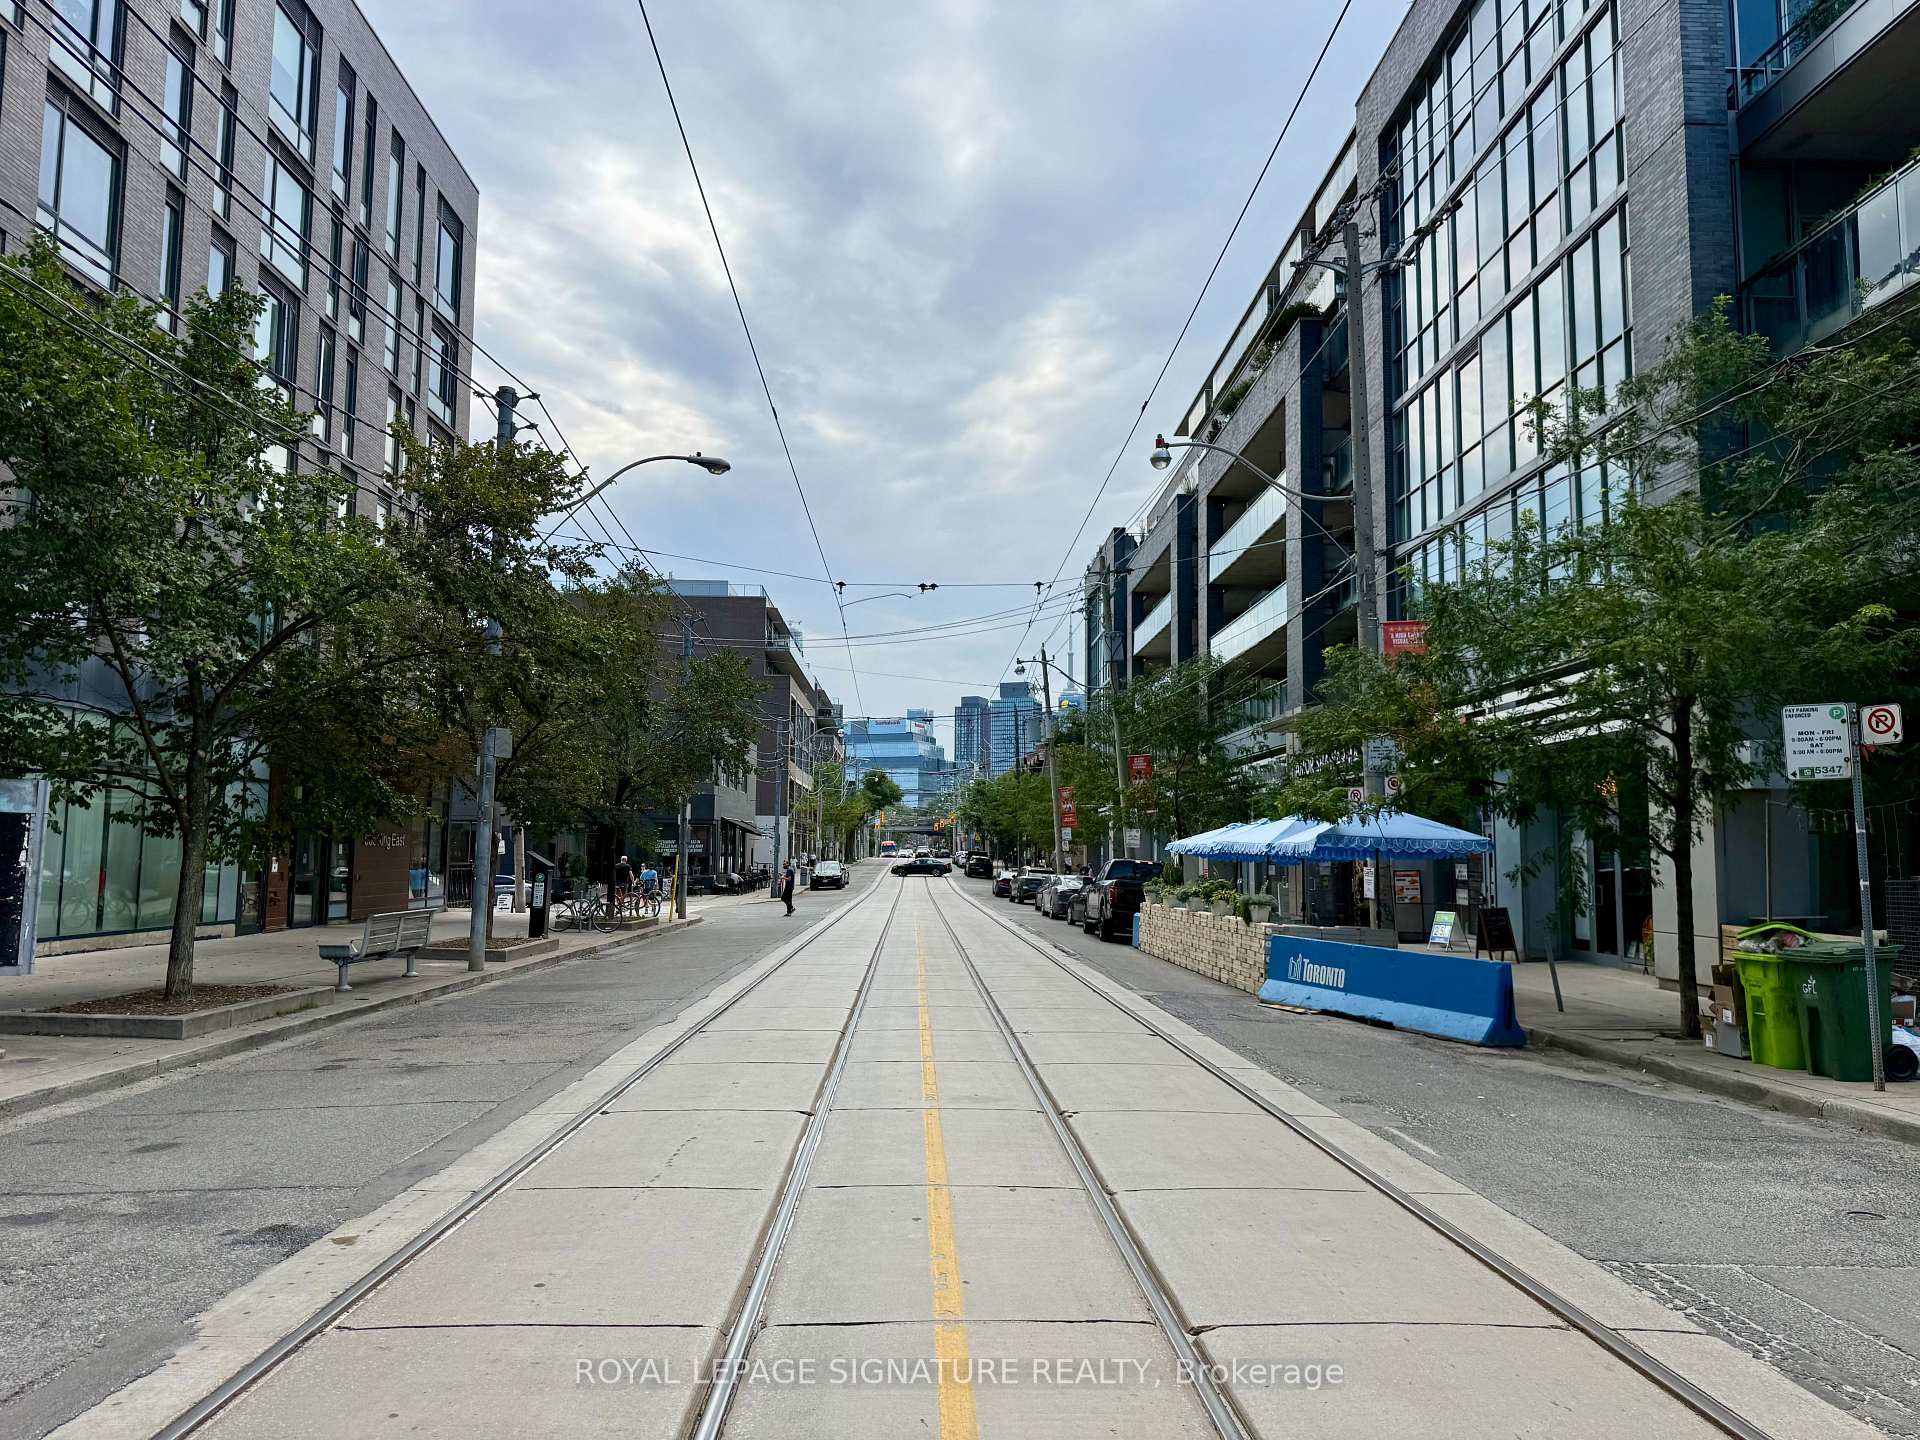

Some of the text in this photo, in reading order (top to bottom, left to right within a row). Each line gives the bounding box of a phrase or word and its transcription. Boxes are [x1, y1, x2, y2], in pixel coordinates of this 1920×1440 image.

[1816, 766, 1842, 774] 5347
[392, 832, 404, 846] East
[1802, 982, 1817, 994] GFL
